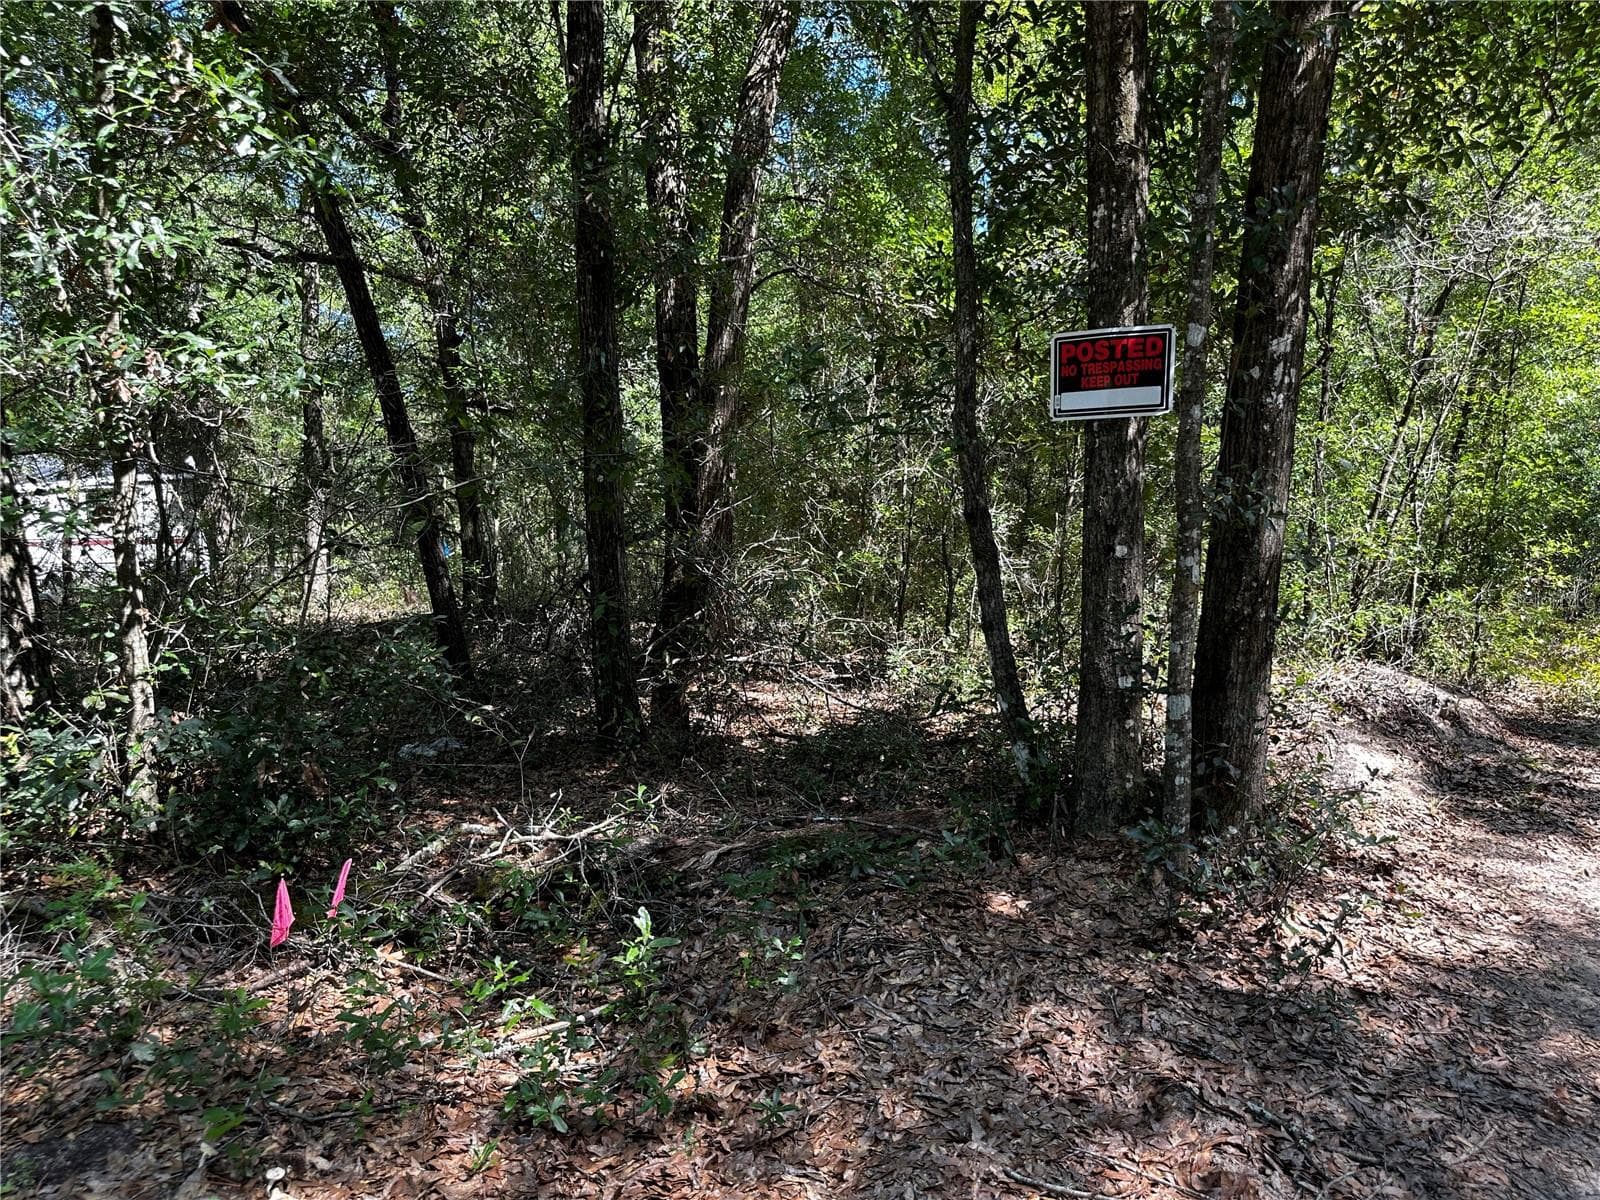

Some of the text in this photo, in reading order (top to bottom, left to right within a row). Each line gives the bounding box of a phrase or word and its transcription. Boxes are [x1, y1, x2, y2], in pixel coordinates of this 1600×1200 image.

[1061, 336, 1163, 363] POSTED
[1061, 358, 1162, 376] NO TRESPASSING
[1081, 373, 1139, 389] KEEP OUT
